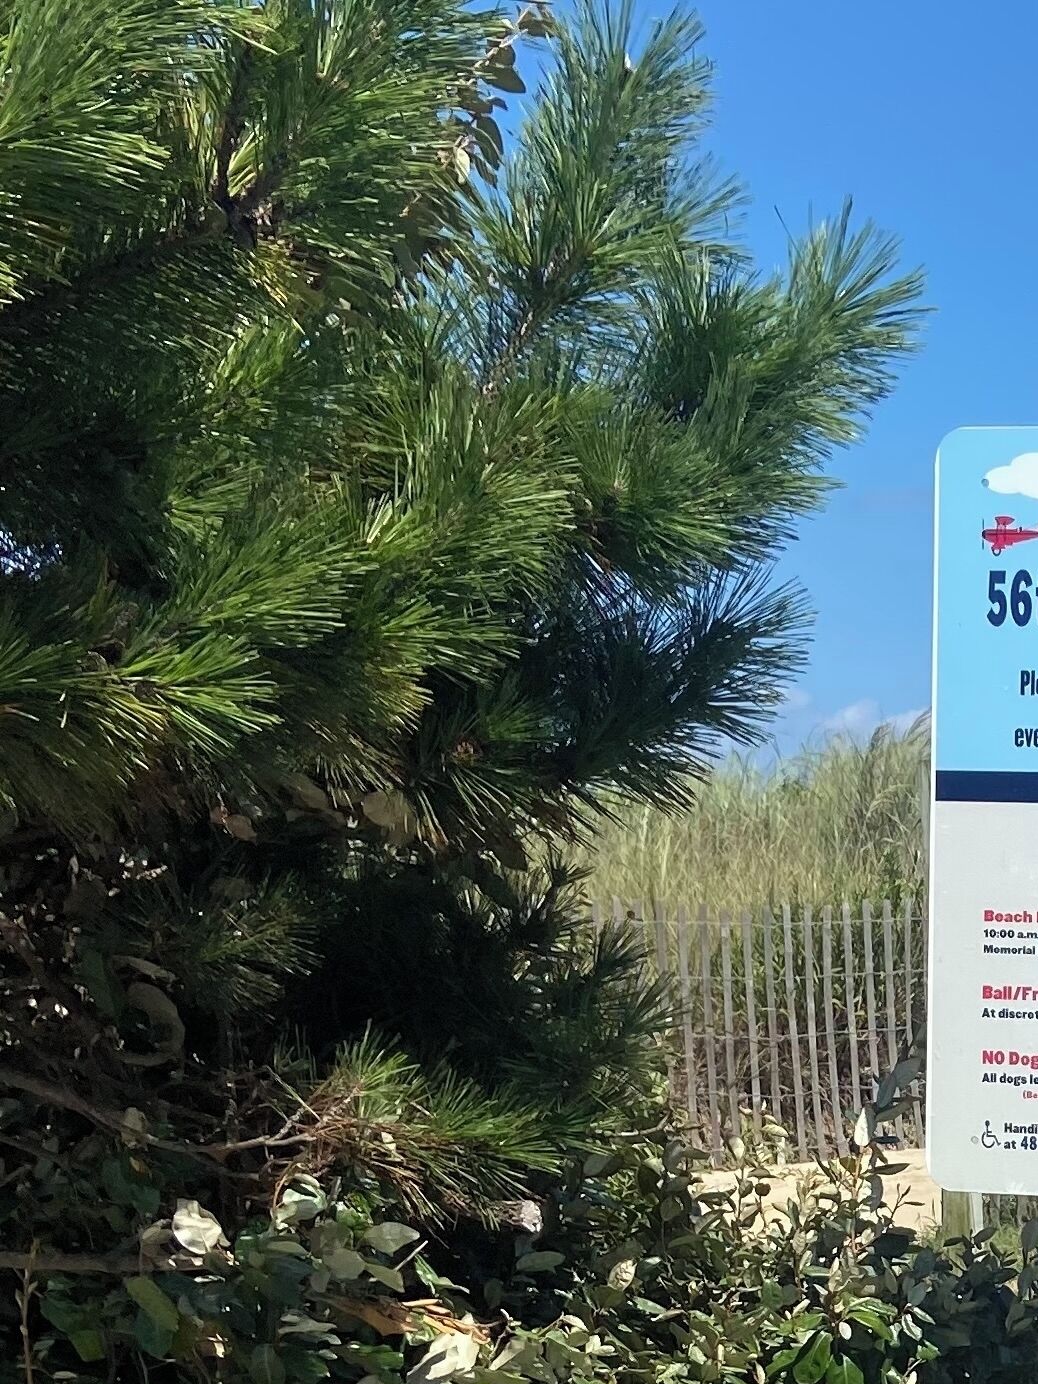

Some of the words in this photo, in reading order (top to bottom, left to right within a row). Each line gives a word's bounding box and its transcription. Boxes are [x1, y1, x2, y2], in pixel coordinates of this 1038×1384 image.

[984, 910, 1032, 923] Beach
[983, 929, 1015, 938] 10:00
[983, 945, 1035, 955] Memorial
[982, 1008, 996, 1018] At
[982, 1051, 1005, 1065] NO
[982, 1073, 997, 1083] All
[1000, 1073, 1027, 1086] dogs
[1003, 1140, 1016, 1150] at
